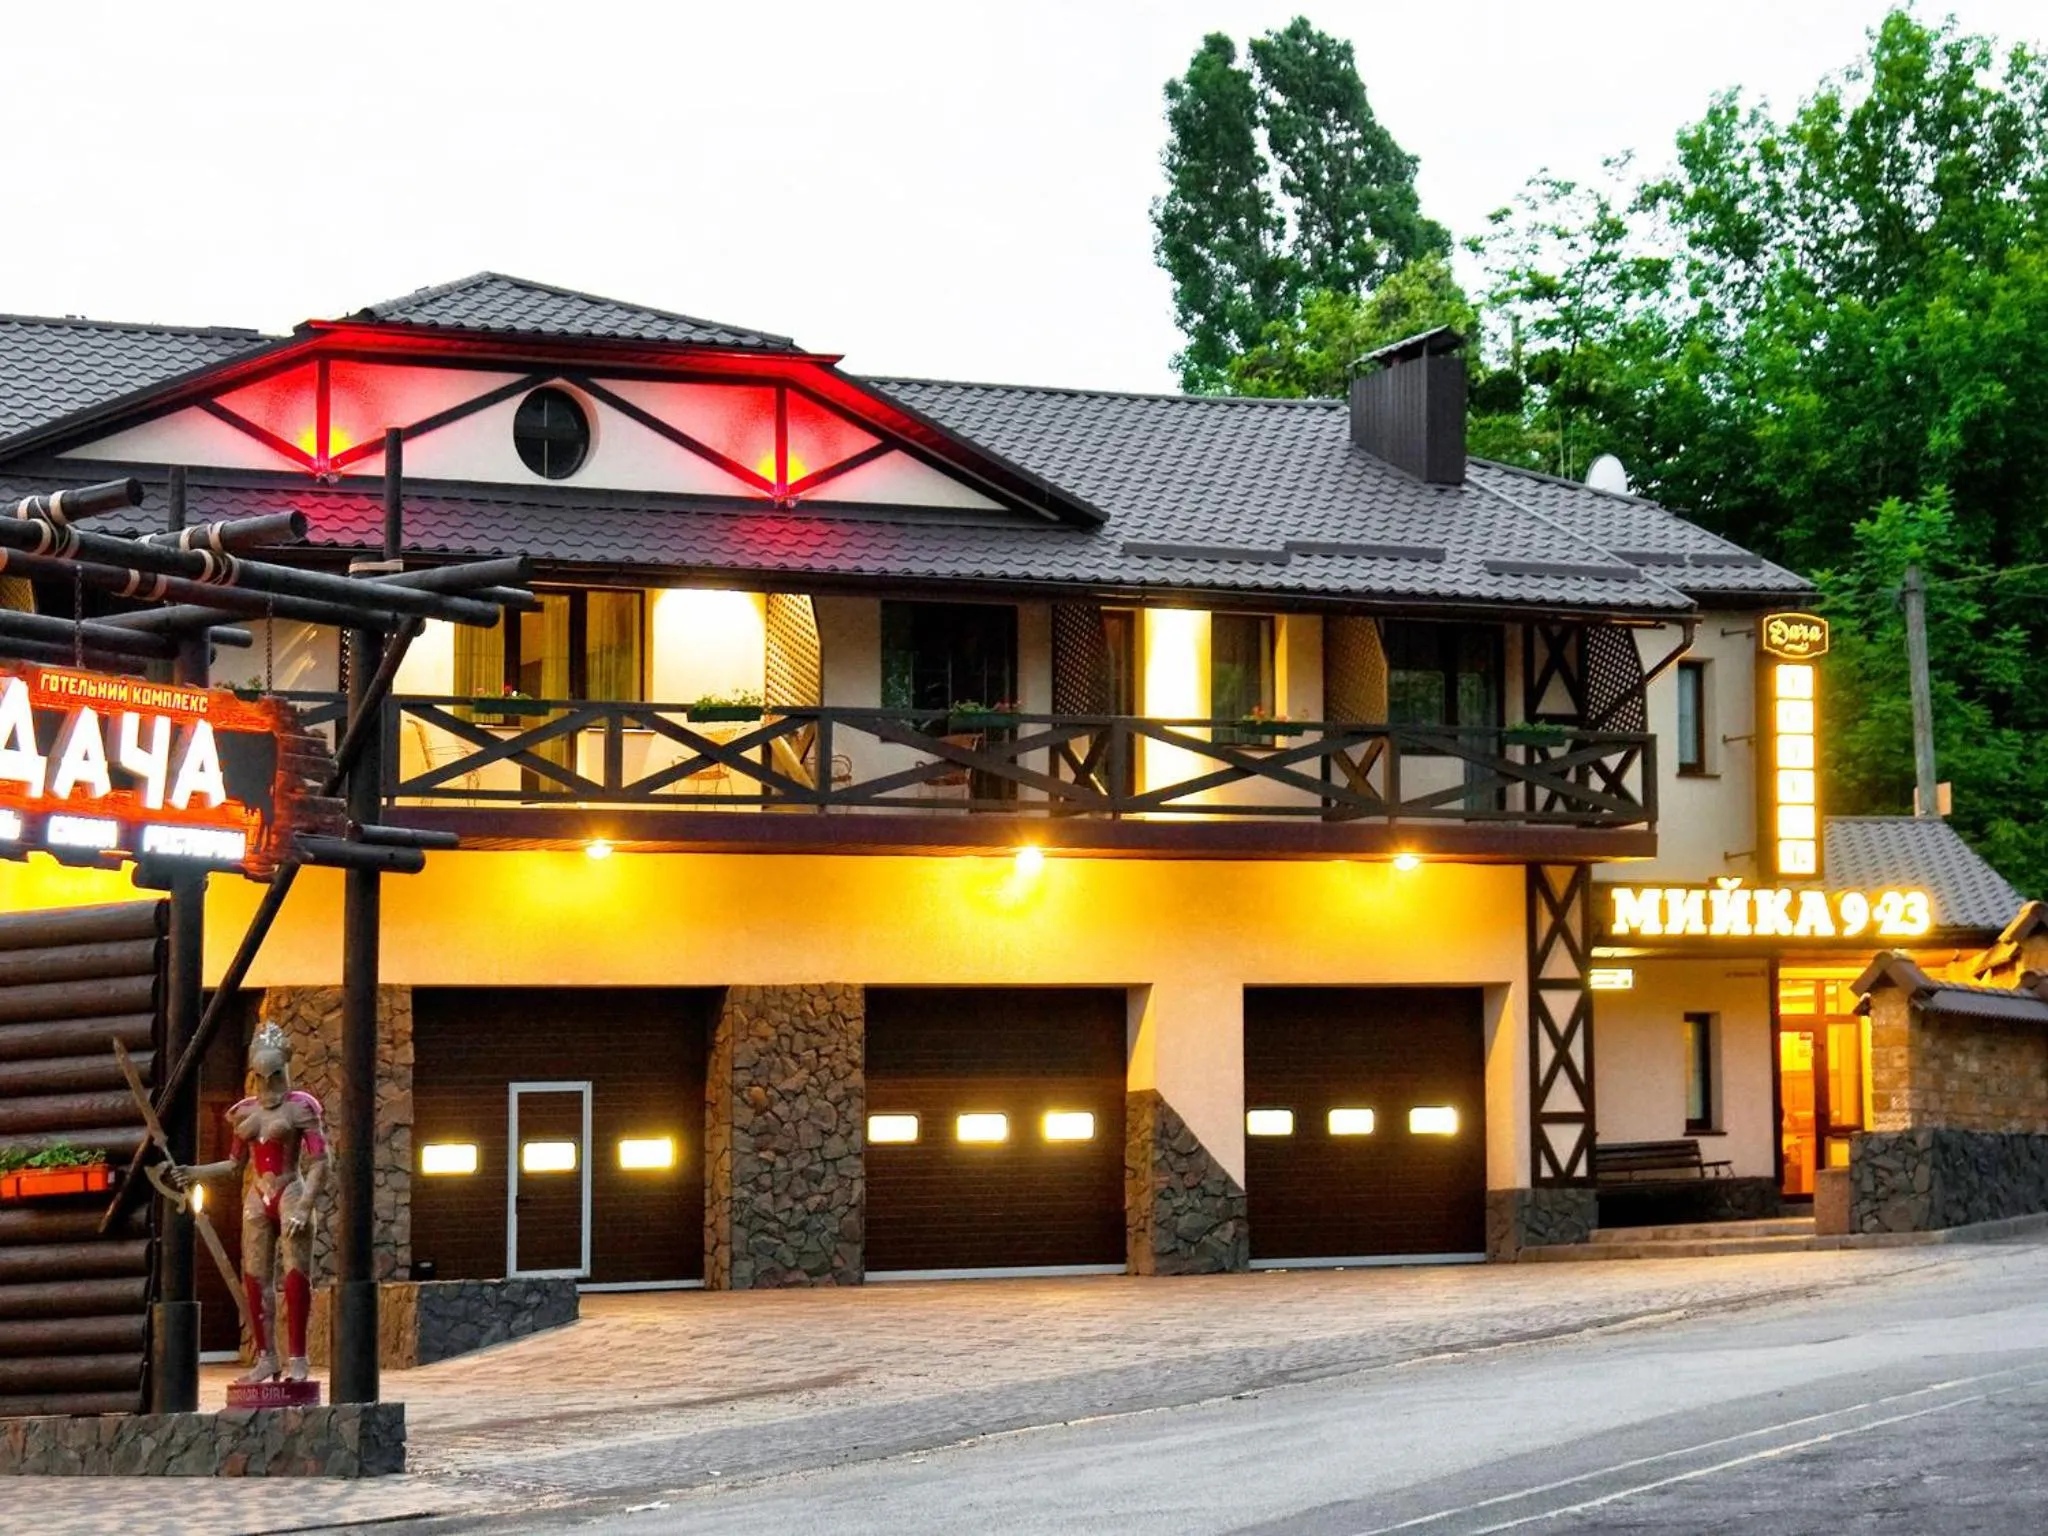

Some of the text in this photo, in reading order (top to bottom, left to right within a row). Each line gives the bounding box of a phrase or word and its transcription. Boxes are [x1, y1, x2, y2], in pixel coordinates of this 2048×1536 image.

[40, 673, 208, 713] ГОТЕЛЬНИЙ КОМПЛЕКС
[0, 676, 227, 811] ДАЧА
[1611, 876, 1836, 937] МИЙКА
